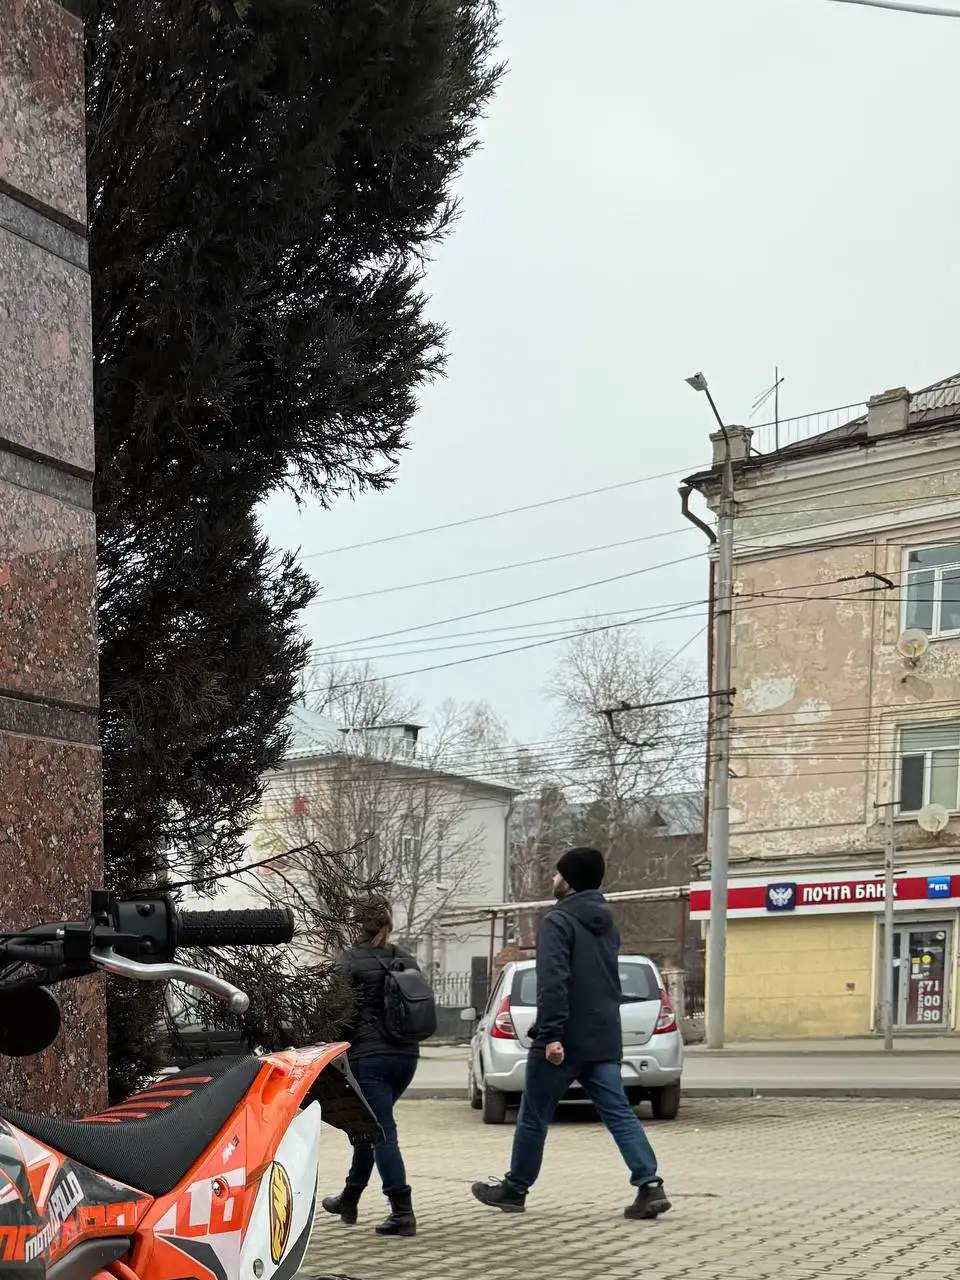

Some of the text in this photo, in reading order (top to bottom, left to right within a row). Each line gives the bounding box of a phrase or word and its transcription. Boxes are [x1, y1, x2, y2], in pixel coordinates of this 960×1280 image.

[803, 885, 851, 902] ПОЧТА
[925, 980, 940, 991] 71
[924, 995, 941, 1007] 00
[923, 1009, 940, 1021] 90
[47, 1171, 85, 1236] APOLLO
